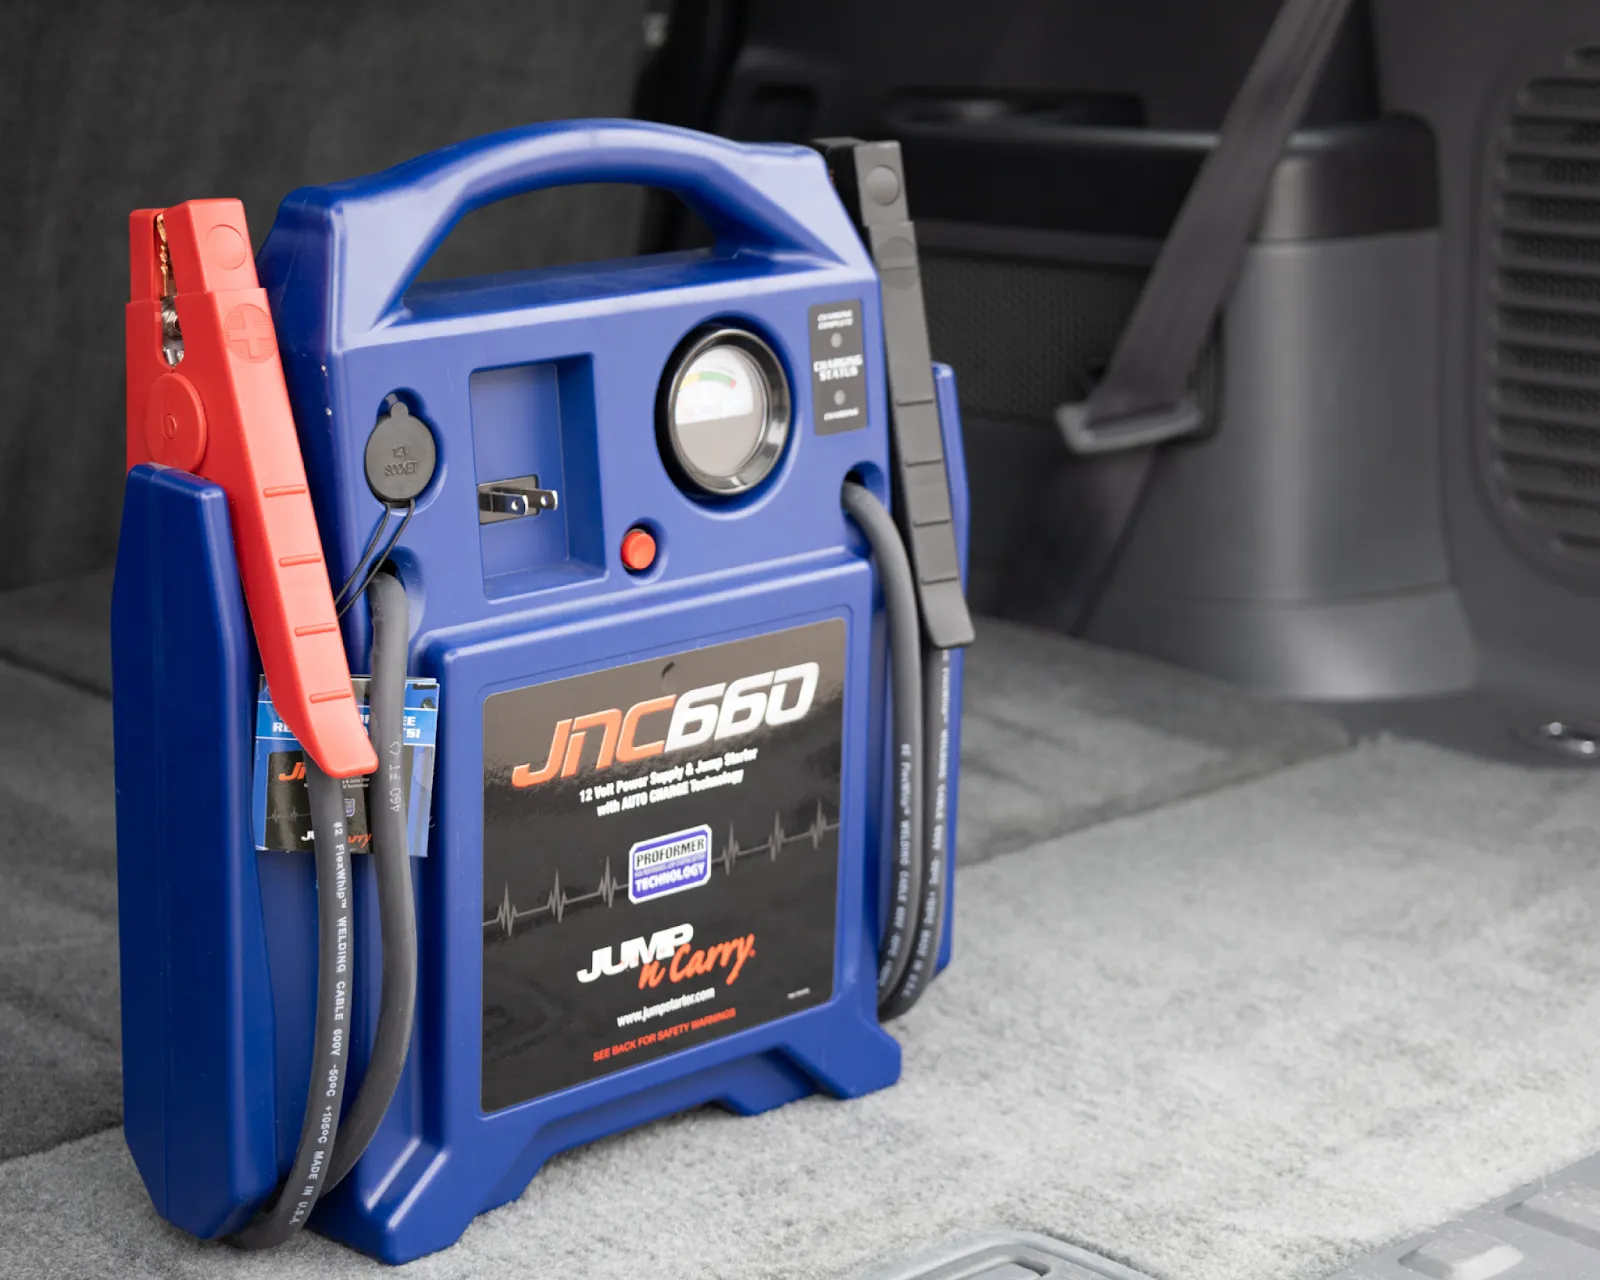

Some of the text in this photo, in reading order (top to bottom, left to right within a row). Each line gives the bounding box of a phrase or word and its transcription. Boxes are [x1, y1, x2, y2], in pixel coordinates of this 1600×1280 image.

[384, 461, 418, 476] SOCKET
[579, 748, 758, 803] 12 Volt Power Supply & Jump Starter
[597, 769, 744, 817] with AUTO CHARGE Technology
[333, 822, 344, 836] #2
[636, 838, 705, 867] PROFORMER
[634, 861, 706, 893] TECHNOLOGY
[336, 916, 348, 973] WELDING
[576, 922, 694, 983] JUMP
[334, 981, 346, 1020] CABLE
[330, 1028, 343, 1056] 600V
[593, 1007, 737, 1062] SEE BACK FOR SAFETY WARNINGS
[308, 1150, 325, 1180] MADE
[301, 1185, 313, 1196] IN
